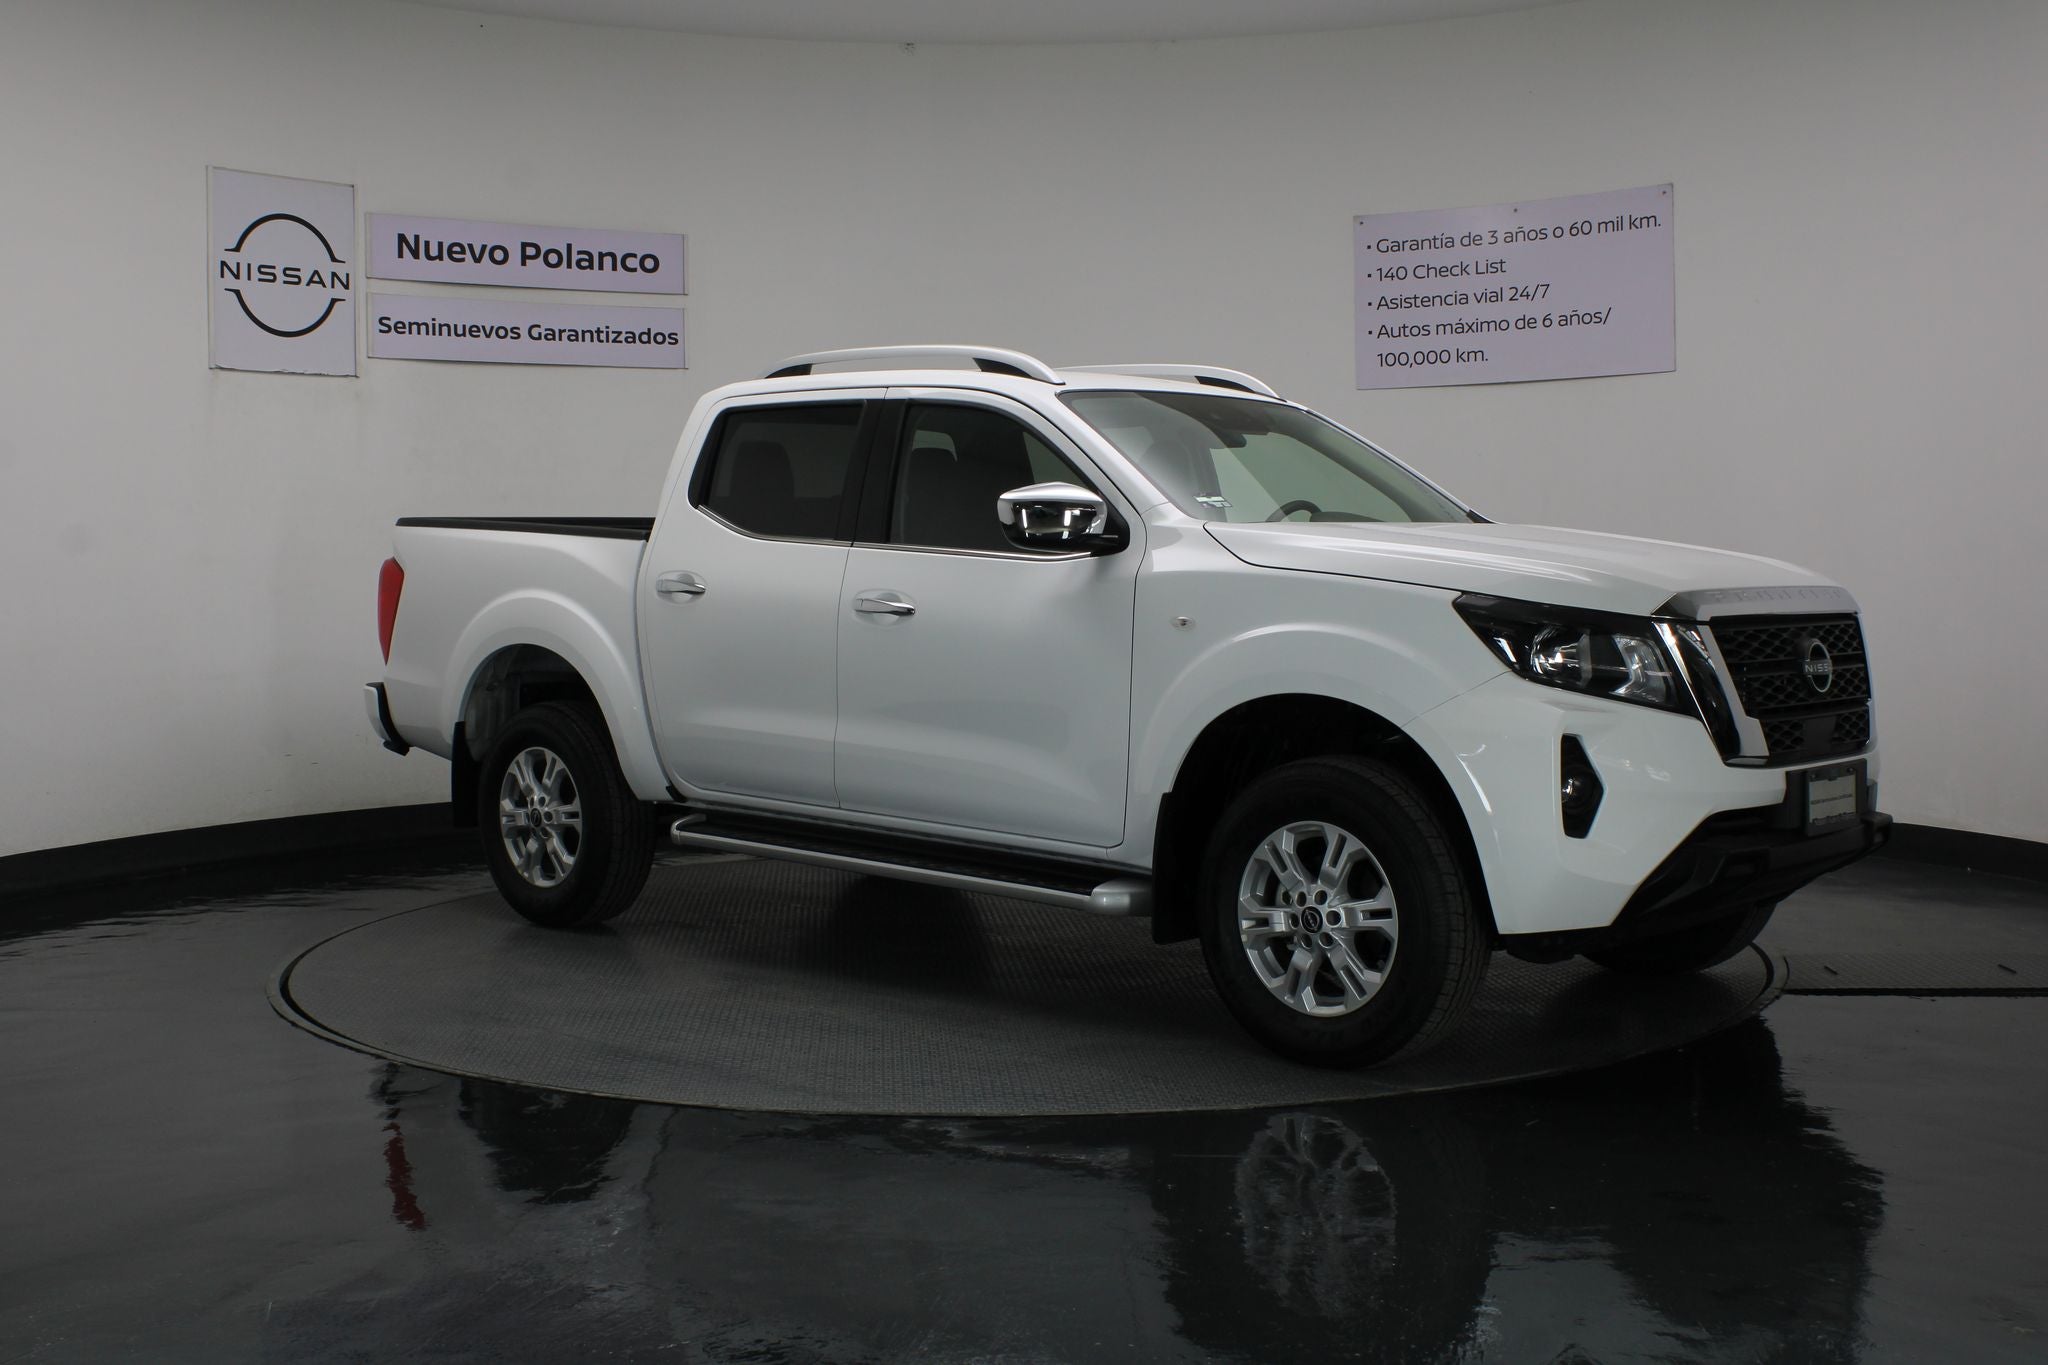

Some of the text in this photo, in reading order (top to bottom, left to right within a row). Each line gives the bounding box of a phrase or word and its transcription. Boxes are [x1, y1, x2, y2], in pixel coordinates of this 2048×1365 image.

[1376, 214, 1661, 254] Garantía de 3 años o 60 mil km.
[397, 232, 660, 274] Nuevo Polanco
[220, 260, 350, 290] NISSAN
[1376, 258, 1507, 282] 140 Check List
[1376, 283, 1550, 311] Asistencia vial 24/7
[378, 316, 679, 346] Seminuevos Garantizados
[1376, 306, 1612, 339] Autos máximo de 6 años/
[1376, 347, 1489, 369] 100,000 km.
